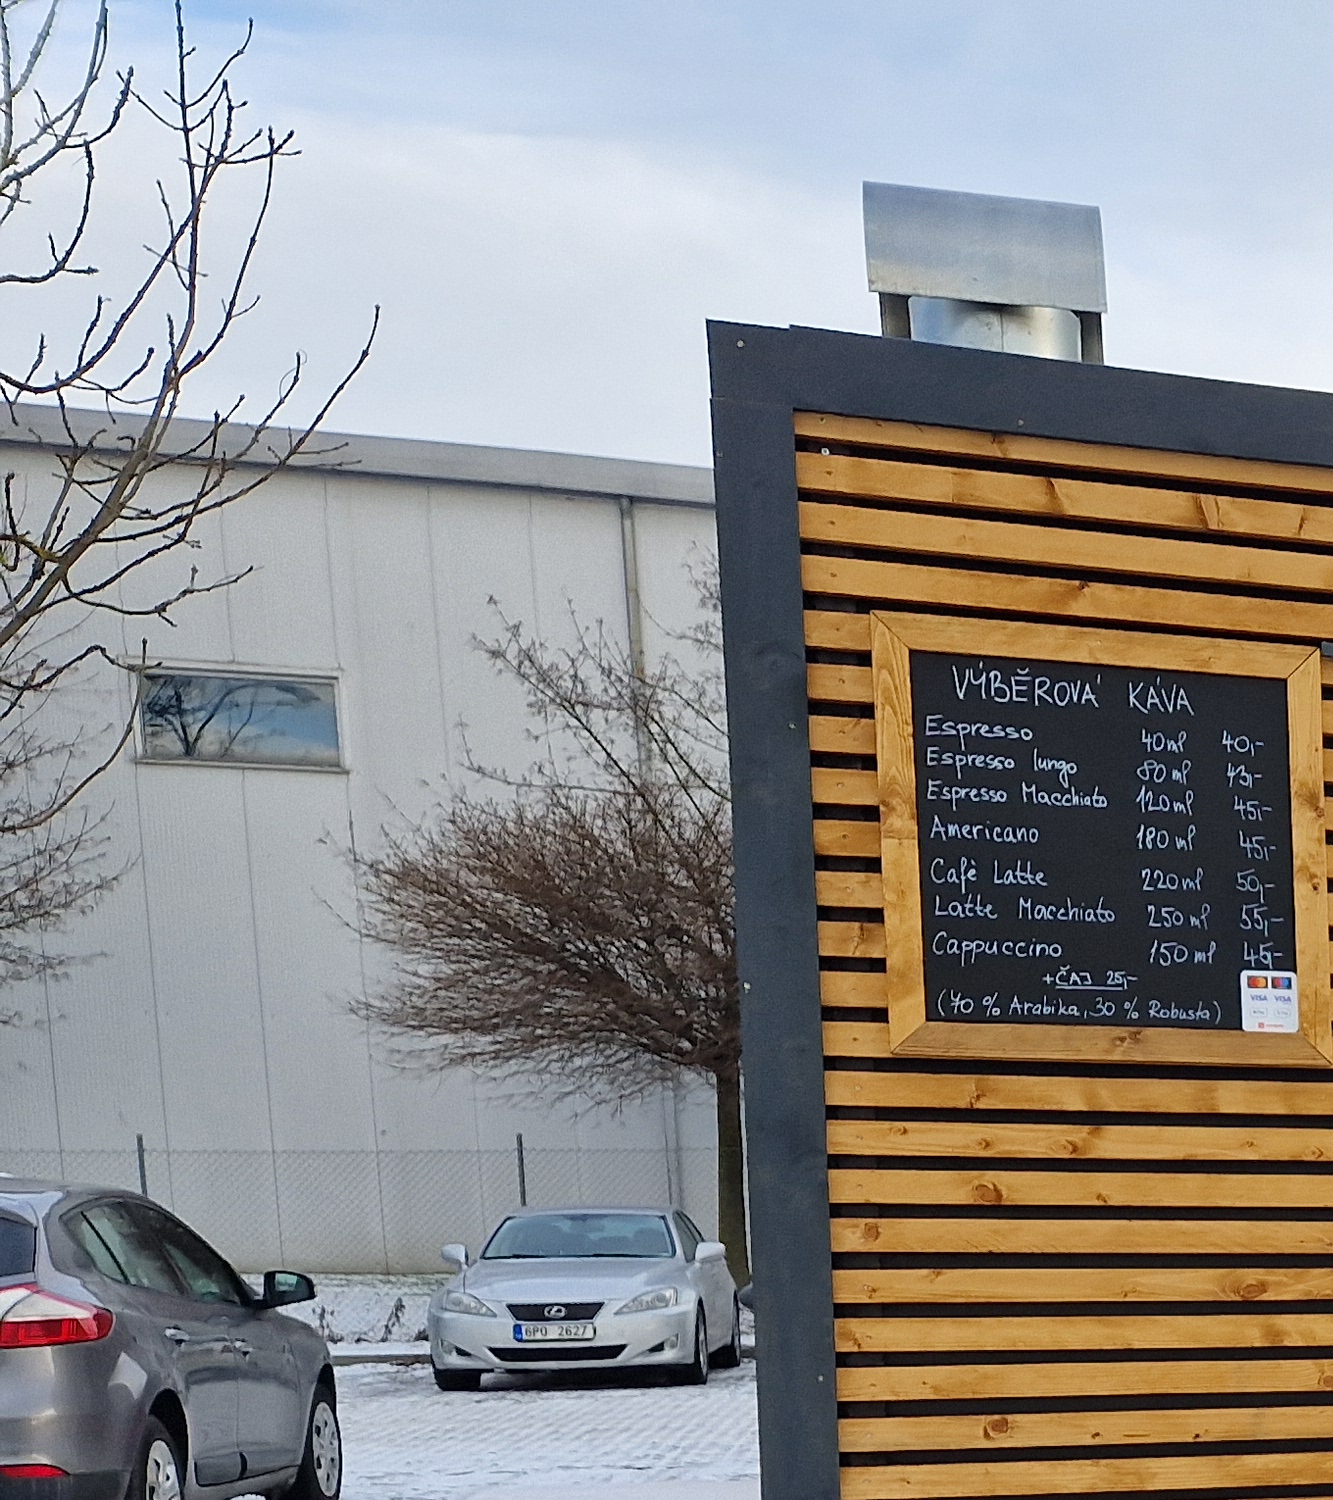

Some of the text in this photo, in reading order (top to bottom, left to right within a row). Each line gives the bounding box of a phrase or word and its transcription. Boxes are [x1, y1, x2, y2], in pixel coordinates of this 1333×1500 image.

[952, 660, 1194, 715] VÝBĚROVÁ KÁVA
[925, 714, 1033, 750] Espresso
[1222, 730, 1264, 756] 40,-
[926, 747, 1015, 779] Espresso
[1033, 747, 1078, 788] lungo
[927, 778, 1007, 811] Espresso
[1022, 781, 1108, 808] Macchiato
[1234, 795, 1272, 821] 45,-
[930, 815, 1039, 843] Americano
[1238, 830, 1276, 861] 45,-
[993, 859, 1048, 886] Latte
[1236, 869, 1275, 903] 50,-
[934, 894, 998, 920] Latte
[1018, 897, 1115, 923] Macchiato
[1240, 903, 1284, 937] 55,-
[932, 931, 1063, 967] Cappuccino
[1243, 941, 1283, 969] 45,-
[1107, 970, 1138, 990] 25,-
[558, 1325, 587, 1337] 2627
